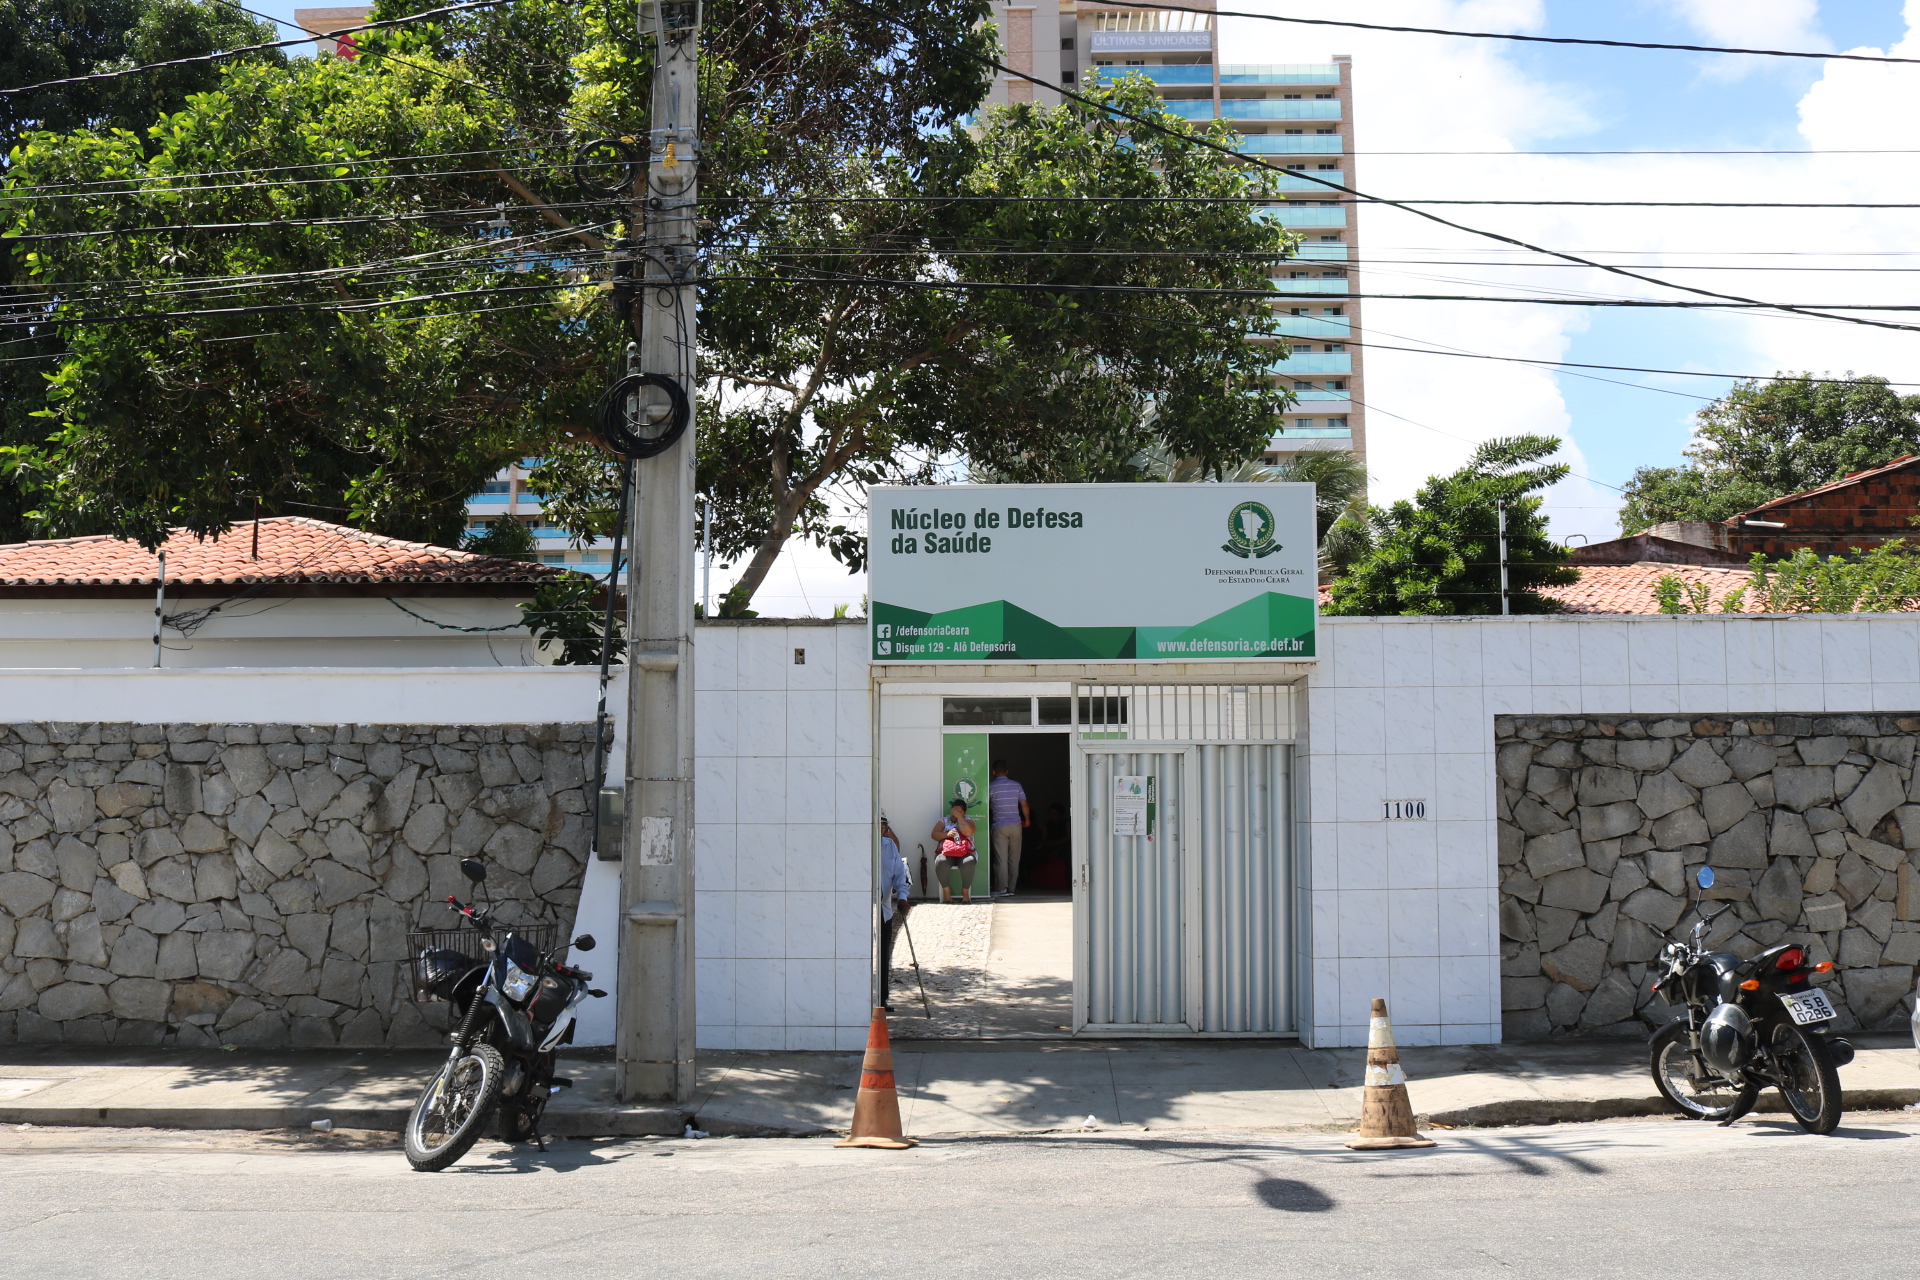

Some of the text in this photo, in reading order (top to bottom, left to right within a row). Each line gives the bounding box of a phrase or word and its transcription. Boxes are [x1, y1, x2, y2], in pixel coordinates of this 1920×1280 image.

[1094, 33, 1210, 46] ÚLTIMAS UNIDADES
[891, 507, 1084, 530] Núcleo de Defesa
[891, 531, 991, 554] da Saúde
[1204, 568, 1248, 576] DEFENSORIA
[1280, 567, 1304, 575] GERAL
[895, 625, 970, 636] /defensoriaCeara
[895, 642, 925, 654] Disque
[928, 642, 944, 653] 129
[953, 641, 967, 652] Alô
[970, 641, 1016, 652] Defensoria
[1157, 637, 1304, 652] www.defensoria.ce.def.br
[1384, 801, 1425, 818] 1100
[1797, 1006, 1832, 1023] 0286
